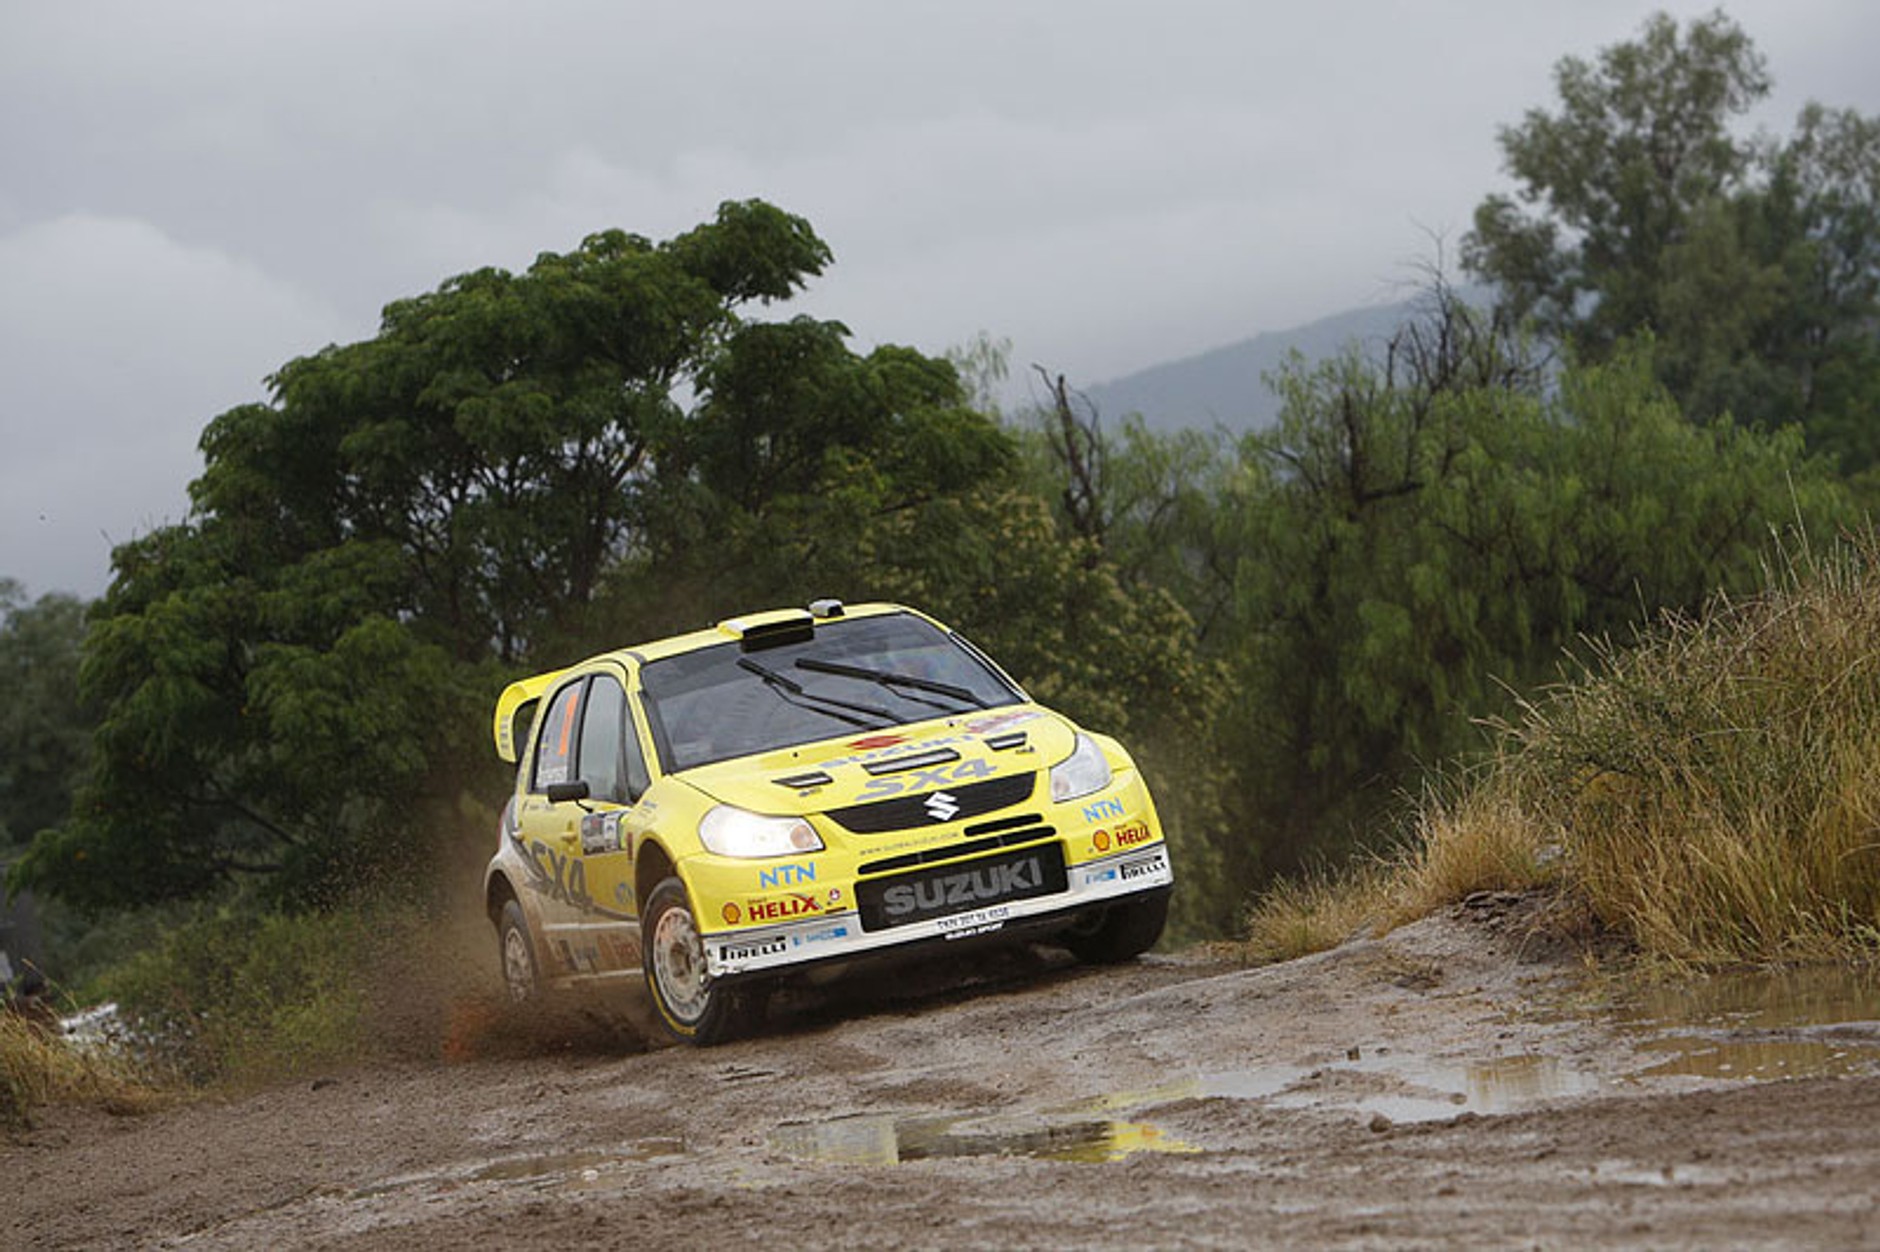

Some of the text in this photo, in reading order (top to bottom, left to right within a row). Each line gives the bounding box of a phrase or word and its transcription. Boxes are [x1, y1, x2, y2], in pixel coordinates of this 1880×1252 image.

[855, 759, 997, 801] SX4
[1082, 797, 1125, 823] NTN
[759, 861, 816, 889] NTN
[883, 857, 1043, 915] SUZUKI
[749, 896, 820, 922] HELIX
[719, 936, 786, 961] PIRELLI
